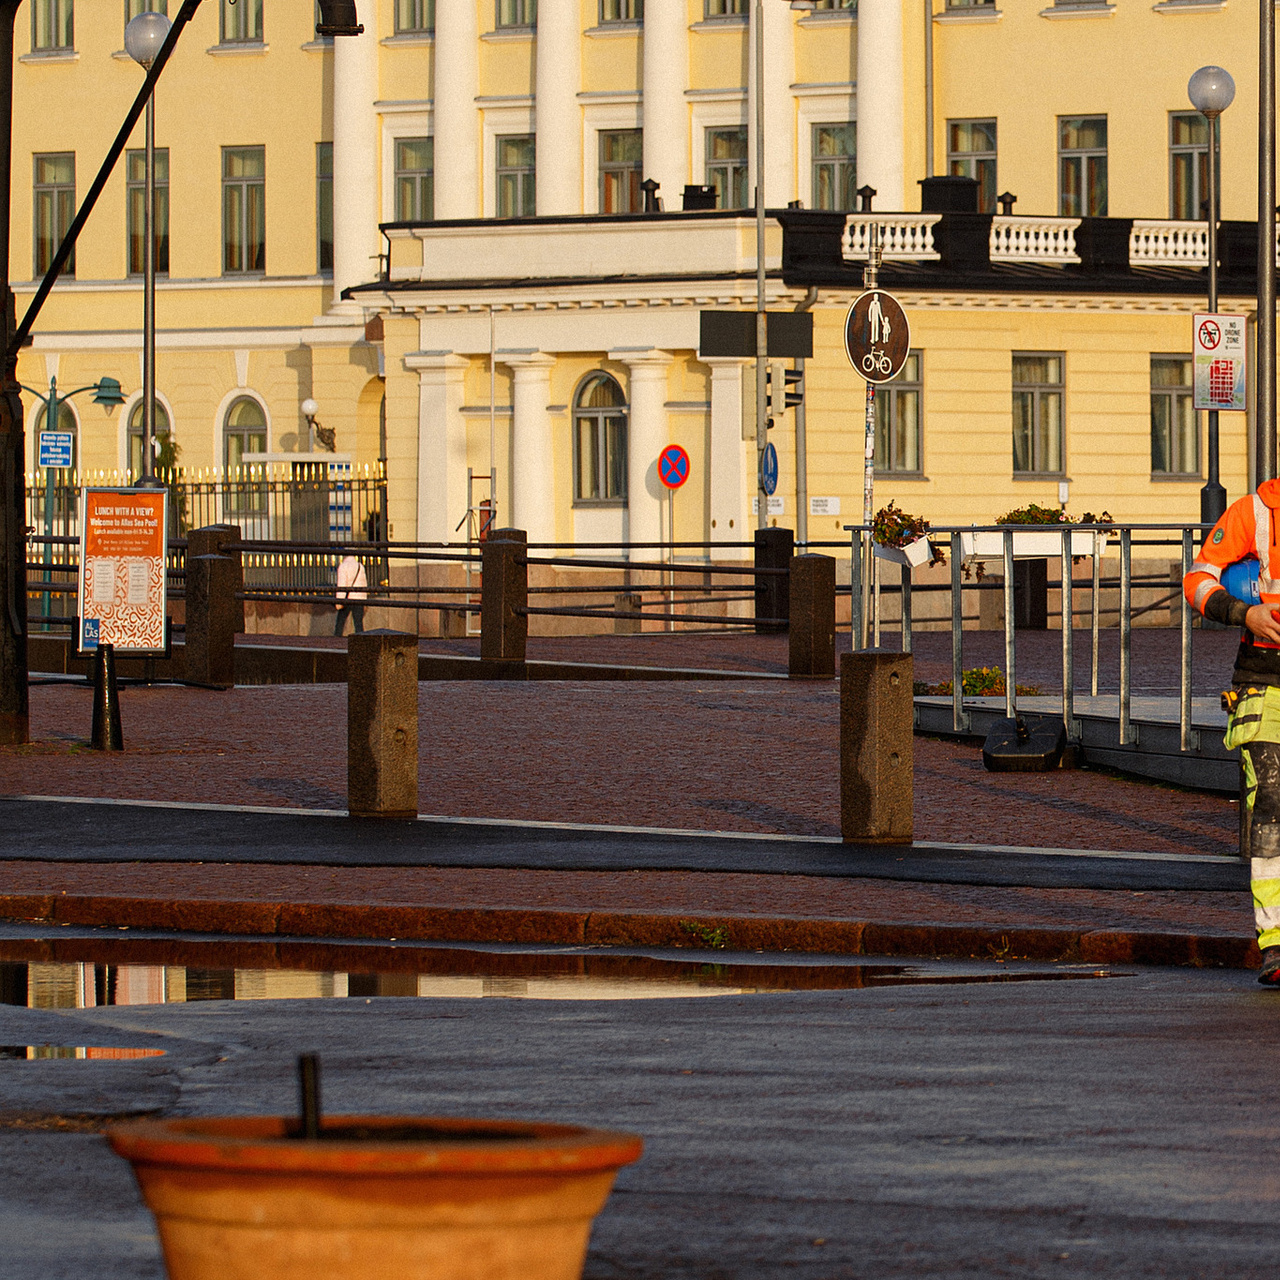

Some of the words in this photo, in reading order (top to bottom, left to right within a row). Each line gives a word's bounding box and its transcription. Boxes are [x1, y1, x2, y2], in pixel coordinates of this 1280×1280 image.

[95, 506, 114, 516] LUNCH
[115, 507, 130, 516] WITH
[136, 507, 154, 516] VIEW?
[90, 518, 113, 526] Welcome
